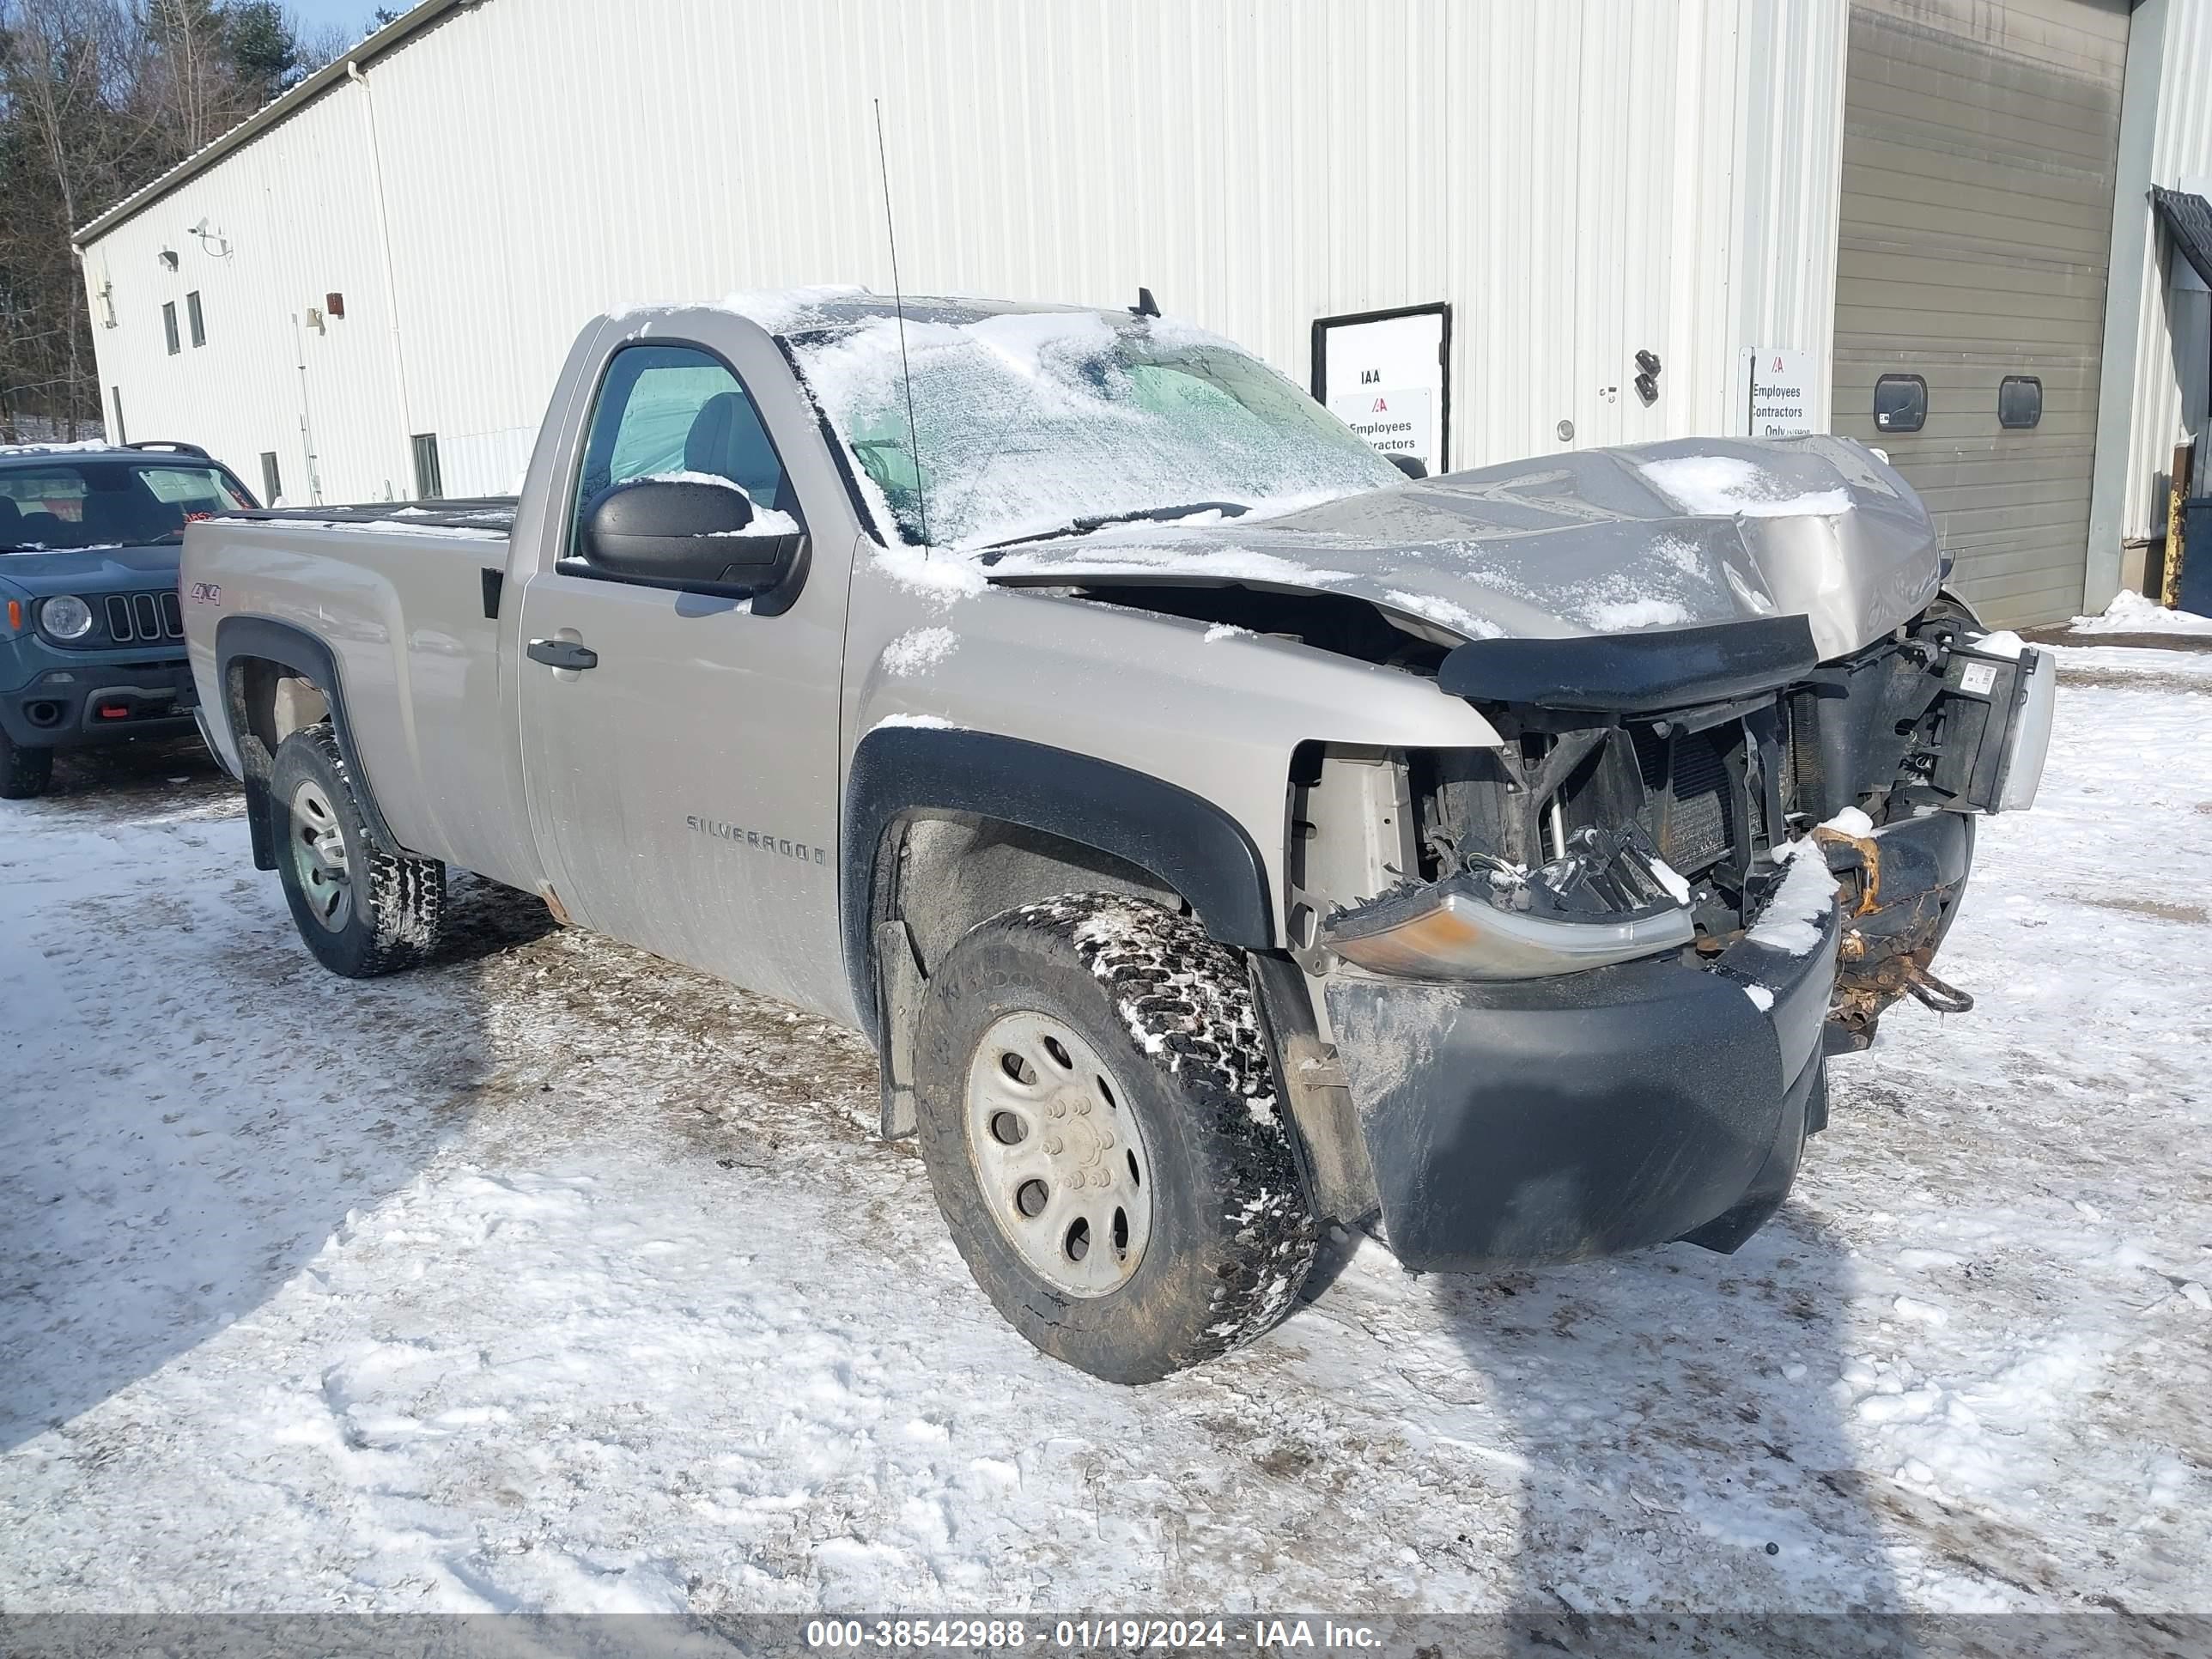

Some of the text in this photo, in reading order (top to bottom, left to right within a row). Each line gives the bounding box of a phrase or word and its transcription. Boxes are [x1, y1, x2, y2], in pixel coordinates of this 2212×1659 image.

[1361, 369, 1380, 385] IAA
[1753, 383, 1801, 400] Employees
[1369, 439, 1415, 451] ractors
[686, 815, 810, 861] SILVERADO
